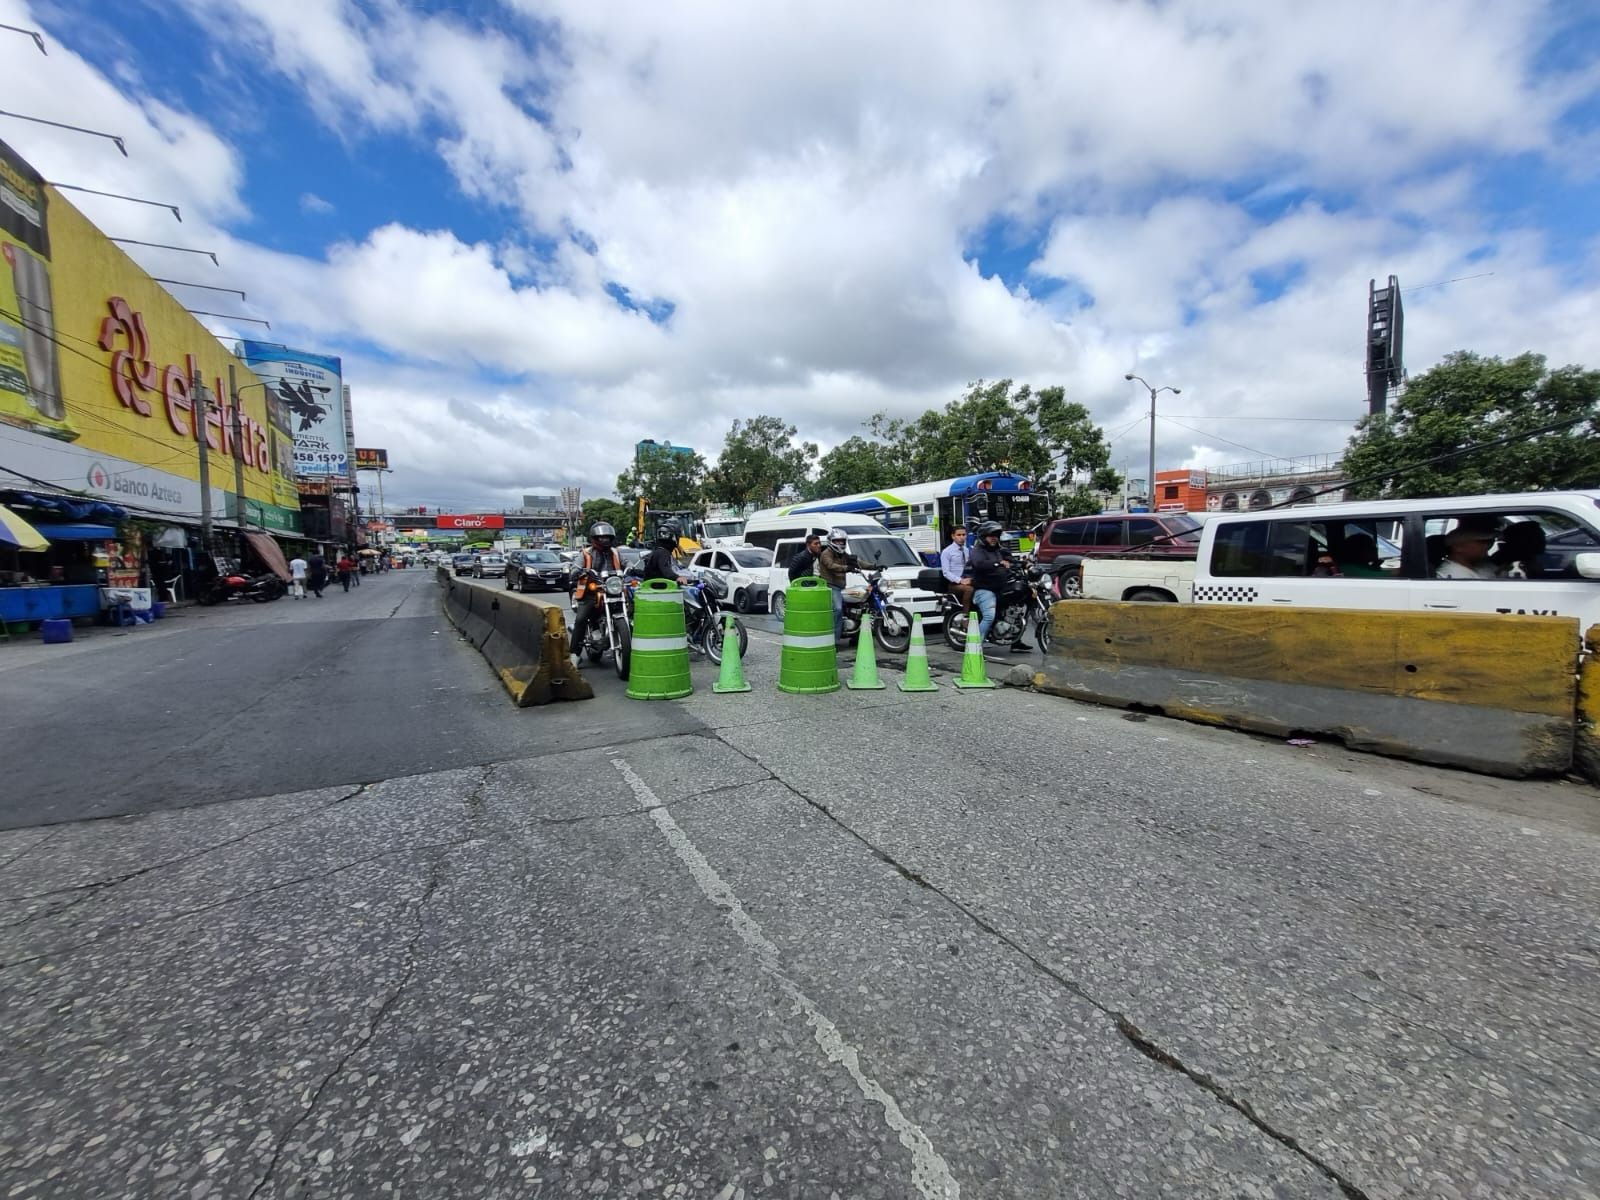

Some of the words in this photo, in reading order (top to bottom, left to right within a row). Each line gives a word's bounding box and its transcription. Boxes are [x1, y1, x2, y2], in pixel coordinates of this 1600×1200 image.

[163, 354, 271, 474] elektra
[317, 453, 345, 463] 1599
[113, 473, 149, 497] Banco
[151, 483, 182, 504] Azteca
[454, 518, 482, 527] Claro
